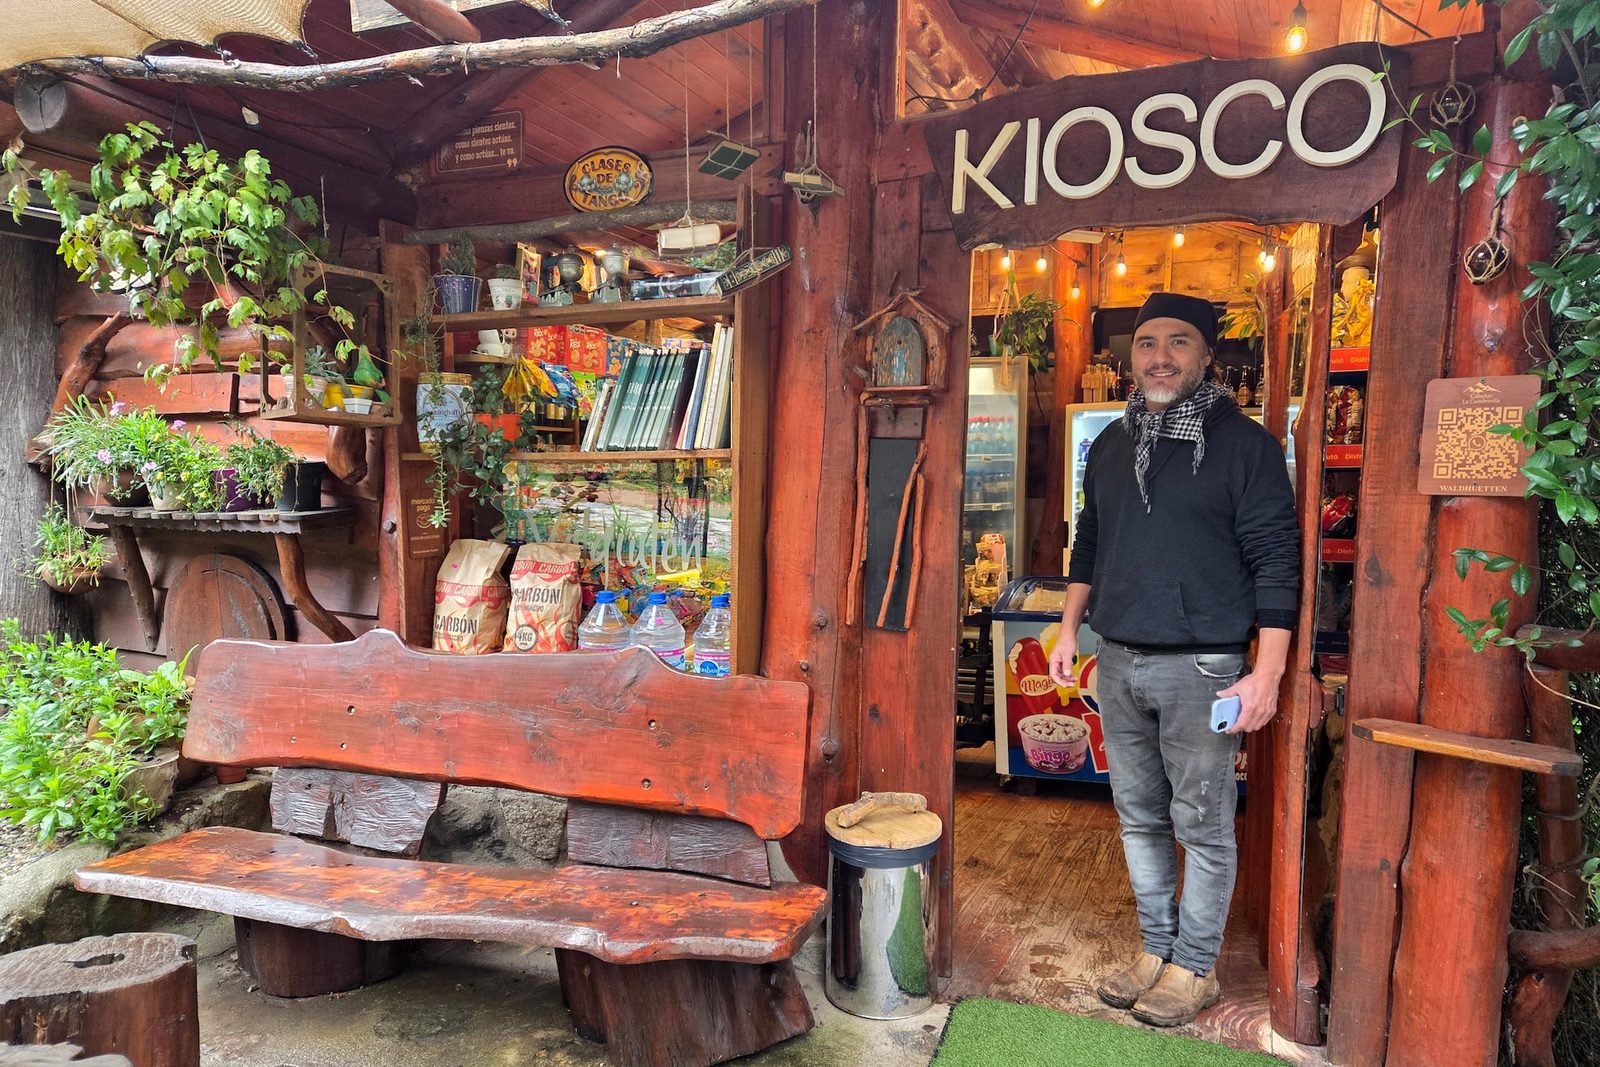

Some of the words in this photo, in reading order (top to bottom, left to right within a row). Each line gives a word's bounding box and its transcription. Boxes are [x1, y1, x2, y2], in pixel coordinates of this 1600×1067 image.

[471, 138, 491, 147] sientes
[951, 62, 1387, 214] KIOSCO
[455, 155, 459, 163] y
[460, 153, 475, 161] como
[582, 158, 631, 174] CLASES
[596, 173, 613, 183] DE
[582, 191, 627, 207] TANGO
[417, 504, 430, 512] pago
[434, 614, 477, 634] CARBÓN
[1030, 745, 1071, 765] Bingo
